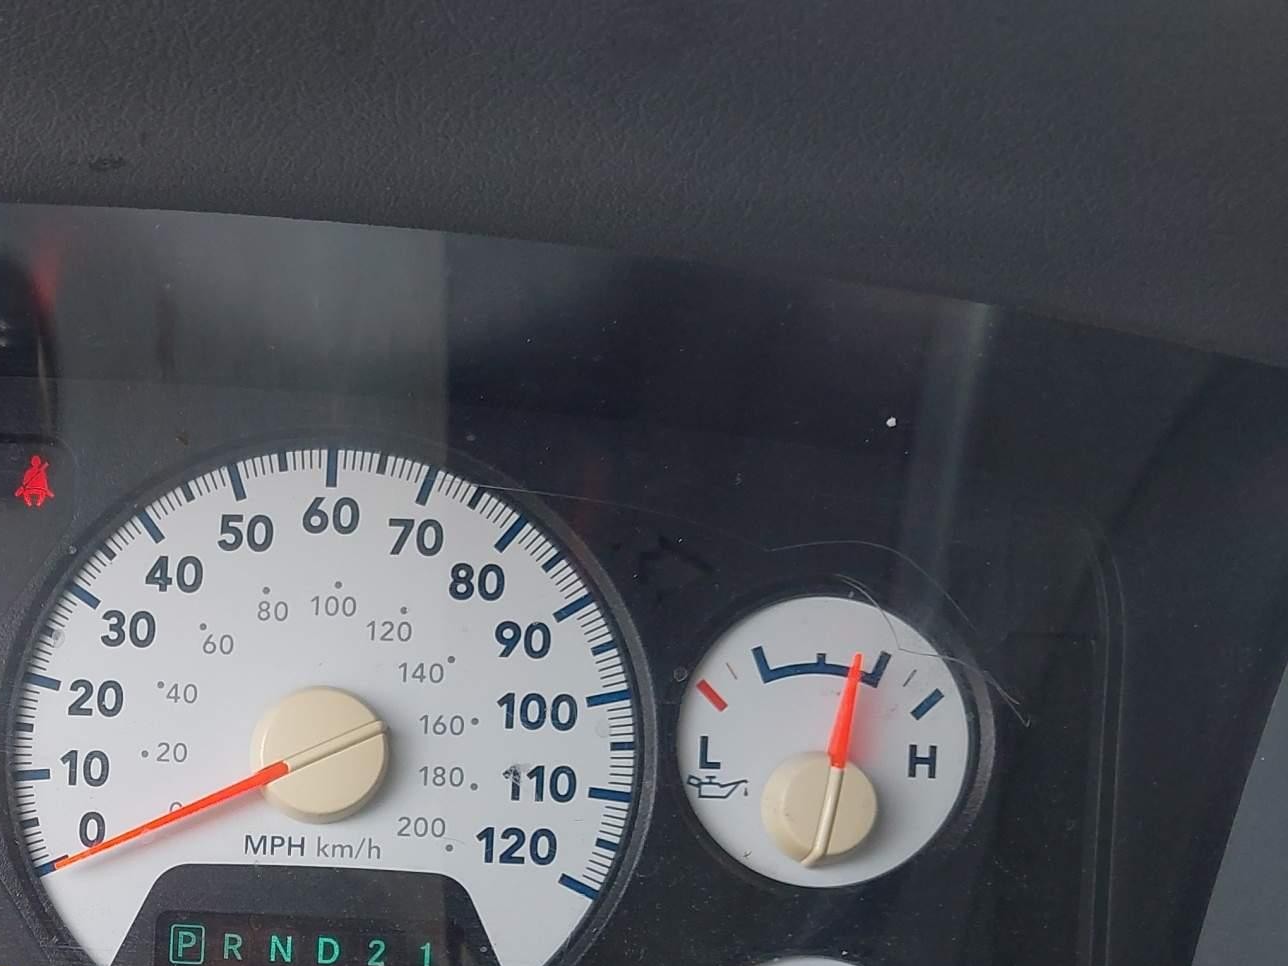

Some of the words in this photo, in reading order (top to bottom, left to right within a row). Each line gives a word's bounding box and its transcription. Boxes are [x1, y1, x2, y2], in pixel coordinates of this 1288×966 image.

[218, 514, 273, 552] 50
[303, 497, 359, 534] 60
[389, 518, 443, 556] 70
[146, 556, 203, 593] 40
[449, 563, 504, 601] 80
[258, 601, 288, 621] 80
[311, 596, 356, 617] 100
[101, 610, 155, 648] 30
[203, 634, 233, 654] 60
[367, 621, 412, 641] 120
[495, 621, 551, 659] 90
[399, 663, 443, 683] 140
[68, 679, 123, 717] 20
[166, 684, 197, 703] 40
[420, 715, 464, 735] 160
[497, 693, 577, 731] 100
[60, 750, 109, 787] 10
[157, 743, 187, 762] 20
[699, 736, 720, 769] L
[908, 745, 937, 778] H
[419, 766, 464, 787] 180
[503, 766, 576, 802] 110
[79, 812, 106, 848] 0
[397, 817, 445, 837] 200
[245, 835, 304, 856] MPH
[317, 836, 380, 859] km/h
[476, 827, 557, 865] 120
[178, 931, 196, 957] P
[224, 934, 242, 960] R
[271, 936, 292, 962] N
[318, 938, 339, 963] D
[368, 940, 385, 966] 2
